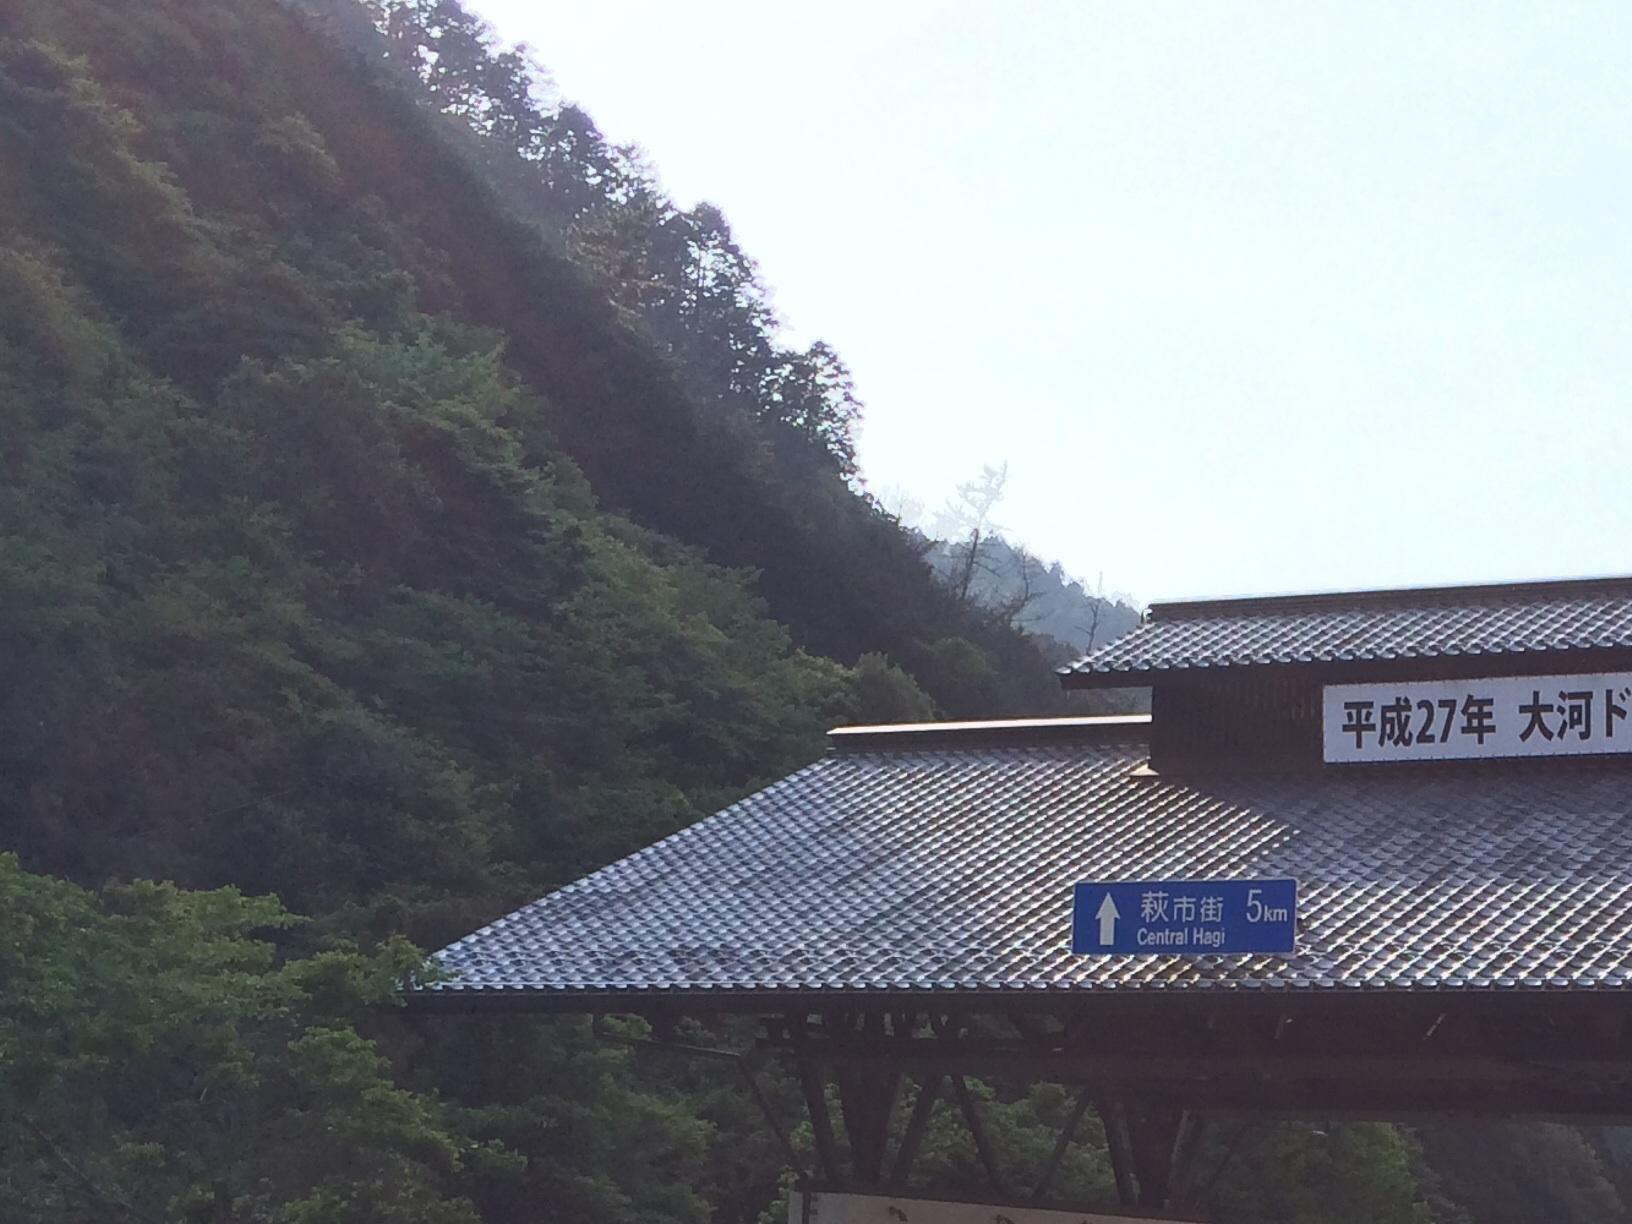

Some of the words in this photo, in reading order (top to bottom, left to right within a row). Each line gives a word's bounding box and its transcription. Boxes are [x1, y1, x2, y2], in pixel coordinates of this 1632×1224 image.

[1341, 694, 1497, 749] 平成27年
[1140, 890, 1223, 923] 萩市街
[1246, 889, 1288, 923] 5km
[1136, 927, 1188, 946] Central
[1192, 927, 1226, 948] Hagi
